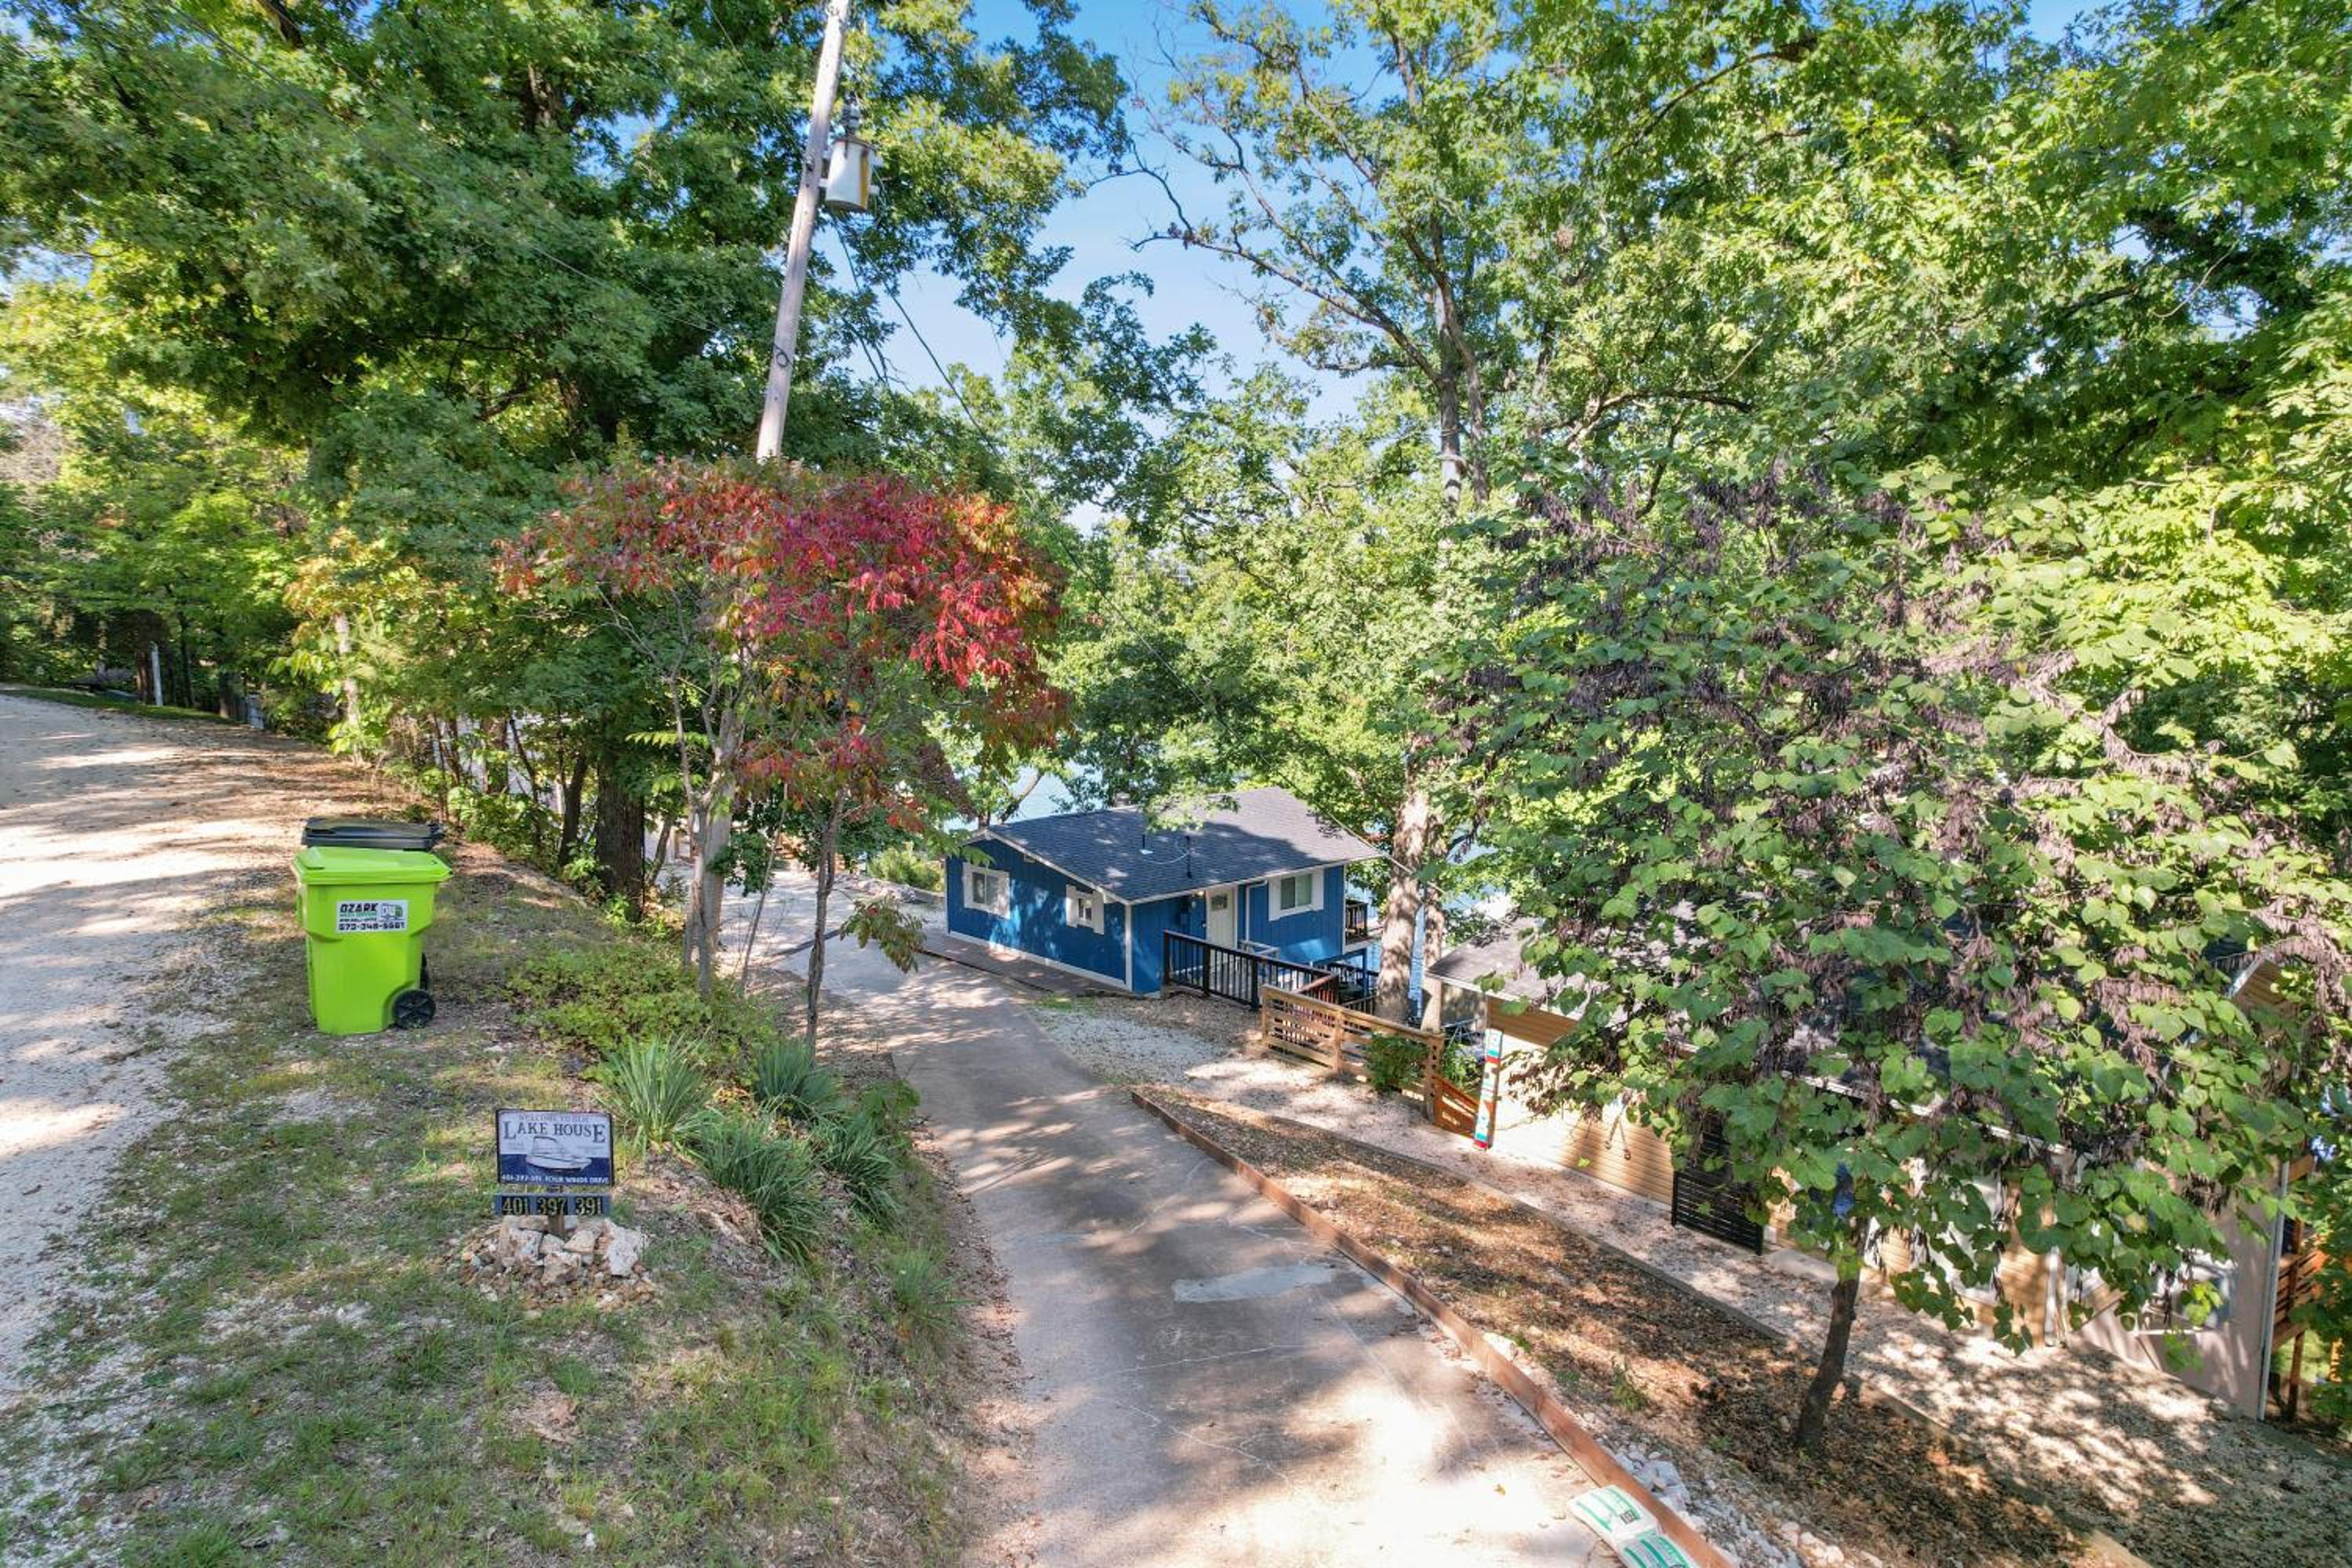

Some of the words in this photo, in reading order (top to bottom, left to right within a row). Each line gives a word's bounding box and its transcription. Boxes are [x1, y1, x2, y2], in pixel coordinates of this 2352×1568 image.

[339, 903, 378, 913] OZARK
[503, 1121, 548, 1139] LAKE
[554, 1123, 606, 1143] HOUSE
[503, 1196, 530, 1214] 401
[537, 1196, 567, 1215] 397
[576, 1196, 601, 1215] 391
